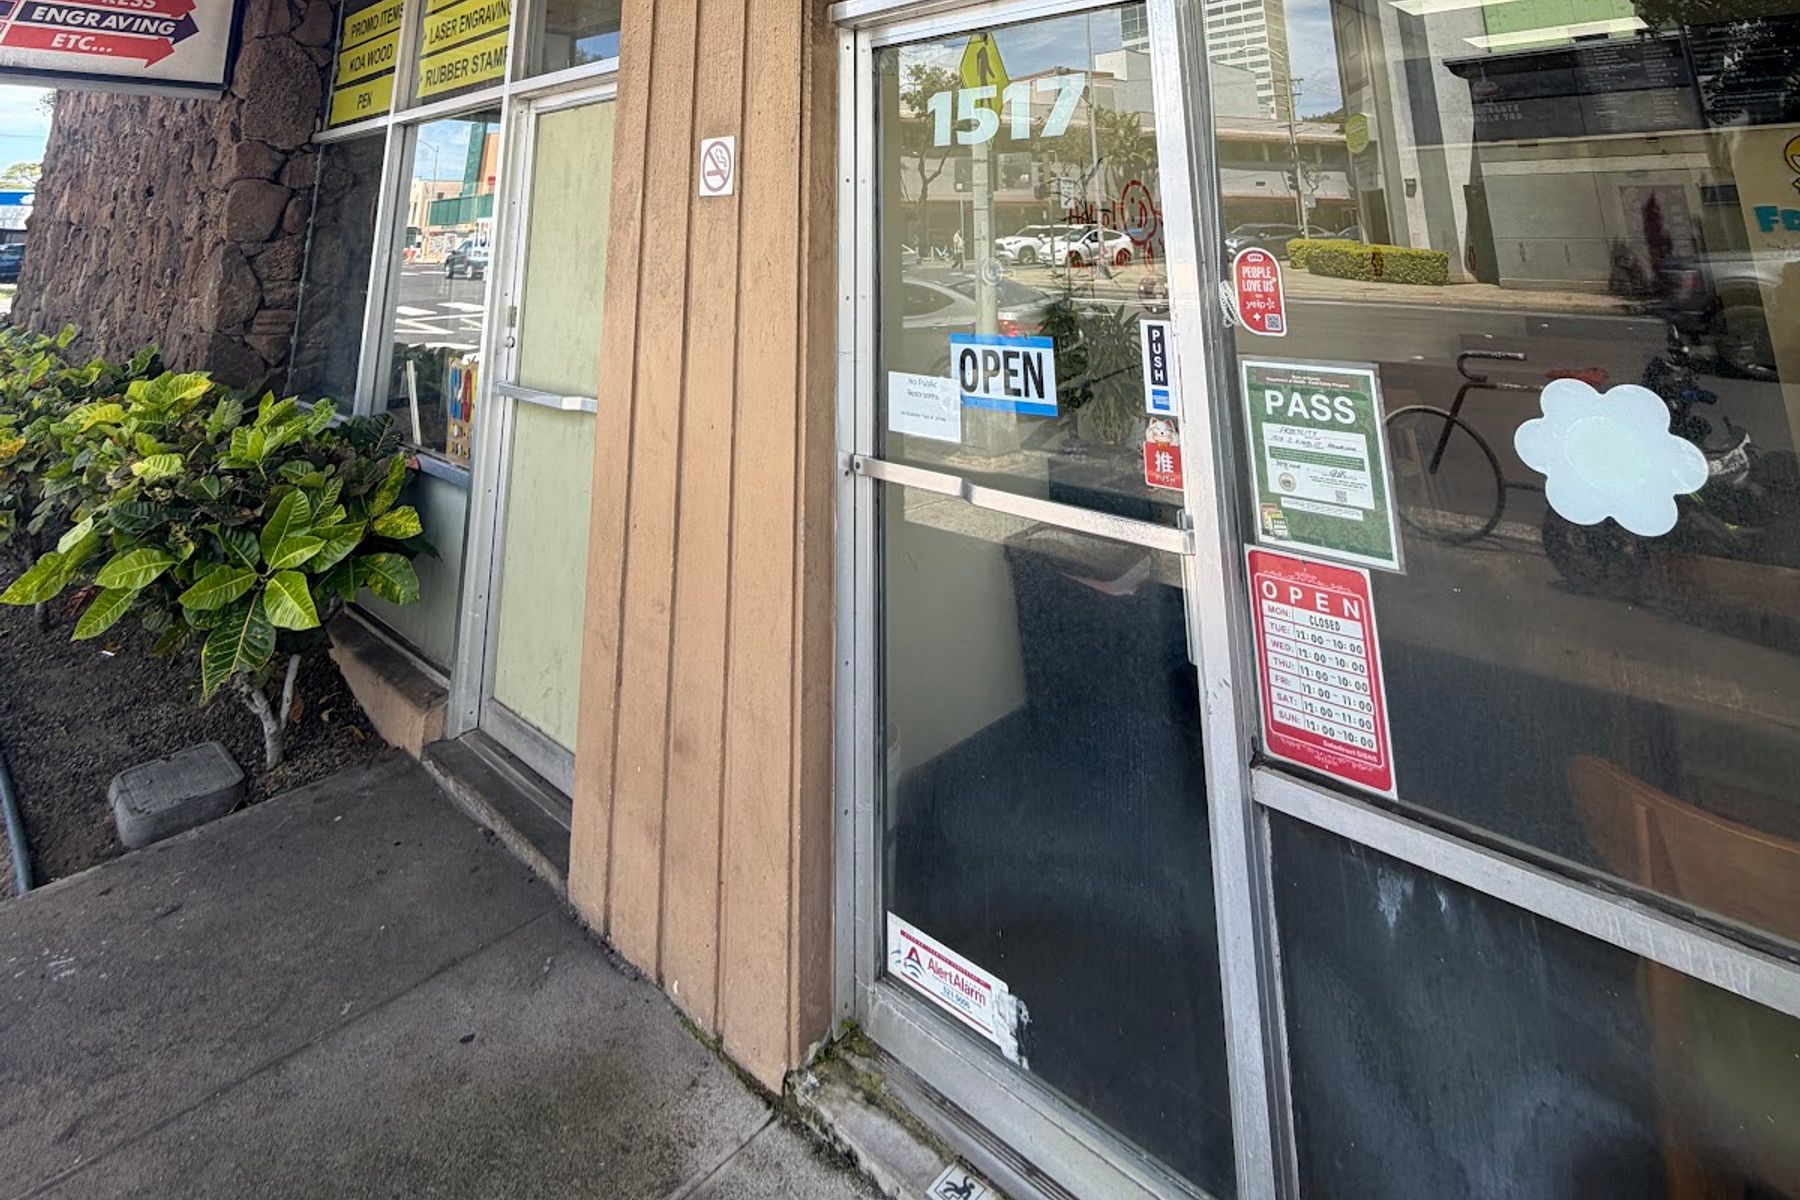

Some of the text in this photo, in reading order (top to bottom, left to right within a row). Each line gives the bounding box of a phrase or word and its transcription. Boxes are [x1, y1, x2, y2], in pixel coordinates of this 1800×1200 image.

[31, 6, 177, 36] ENGRAVING
[351, 13, 380, 40] PROMO
[428, 19, 458, 45] LASER
[51, 33, 113, 53] ETC...
[349, 43, 394, 73] KOA WOOD
[424, 58, 469, 89] RUBBER
[356, 91, 374, 111] PEN
[926, 72, 1087, 147] 1517
[1241, 265, 1272, 279] PEOPLE
[1241, 279, 1275, 293] LOVE US
[1245, 299, 1266, 310] yelp
[1151, 328, 1165, 383] PUSH
[959, 347, 1045, 400] OPEN
[1264, 389, 1356, 425] PASS
[1154, 449, 1175, 474] 推
[1154, 474, 1176, 484] PUSH
[1261, 580, 1361, 620] OPEN
[1267, 604, 1341, 632] MON: CLOSED
[1269, 622, 1290, 635] TUE:
[1270, 639, 1294, 653] WED:
[1273, 657, 1295, 670] THU:
[1274, 674, 1292, 686] FRI:
[1276, 691, 1298, 705] SAT:
[1278, 709, 1300, 723] SUN:
[927, 957, 987, 1007] AlertAlarm
